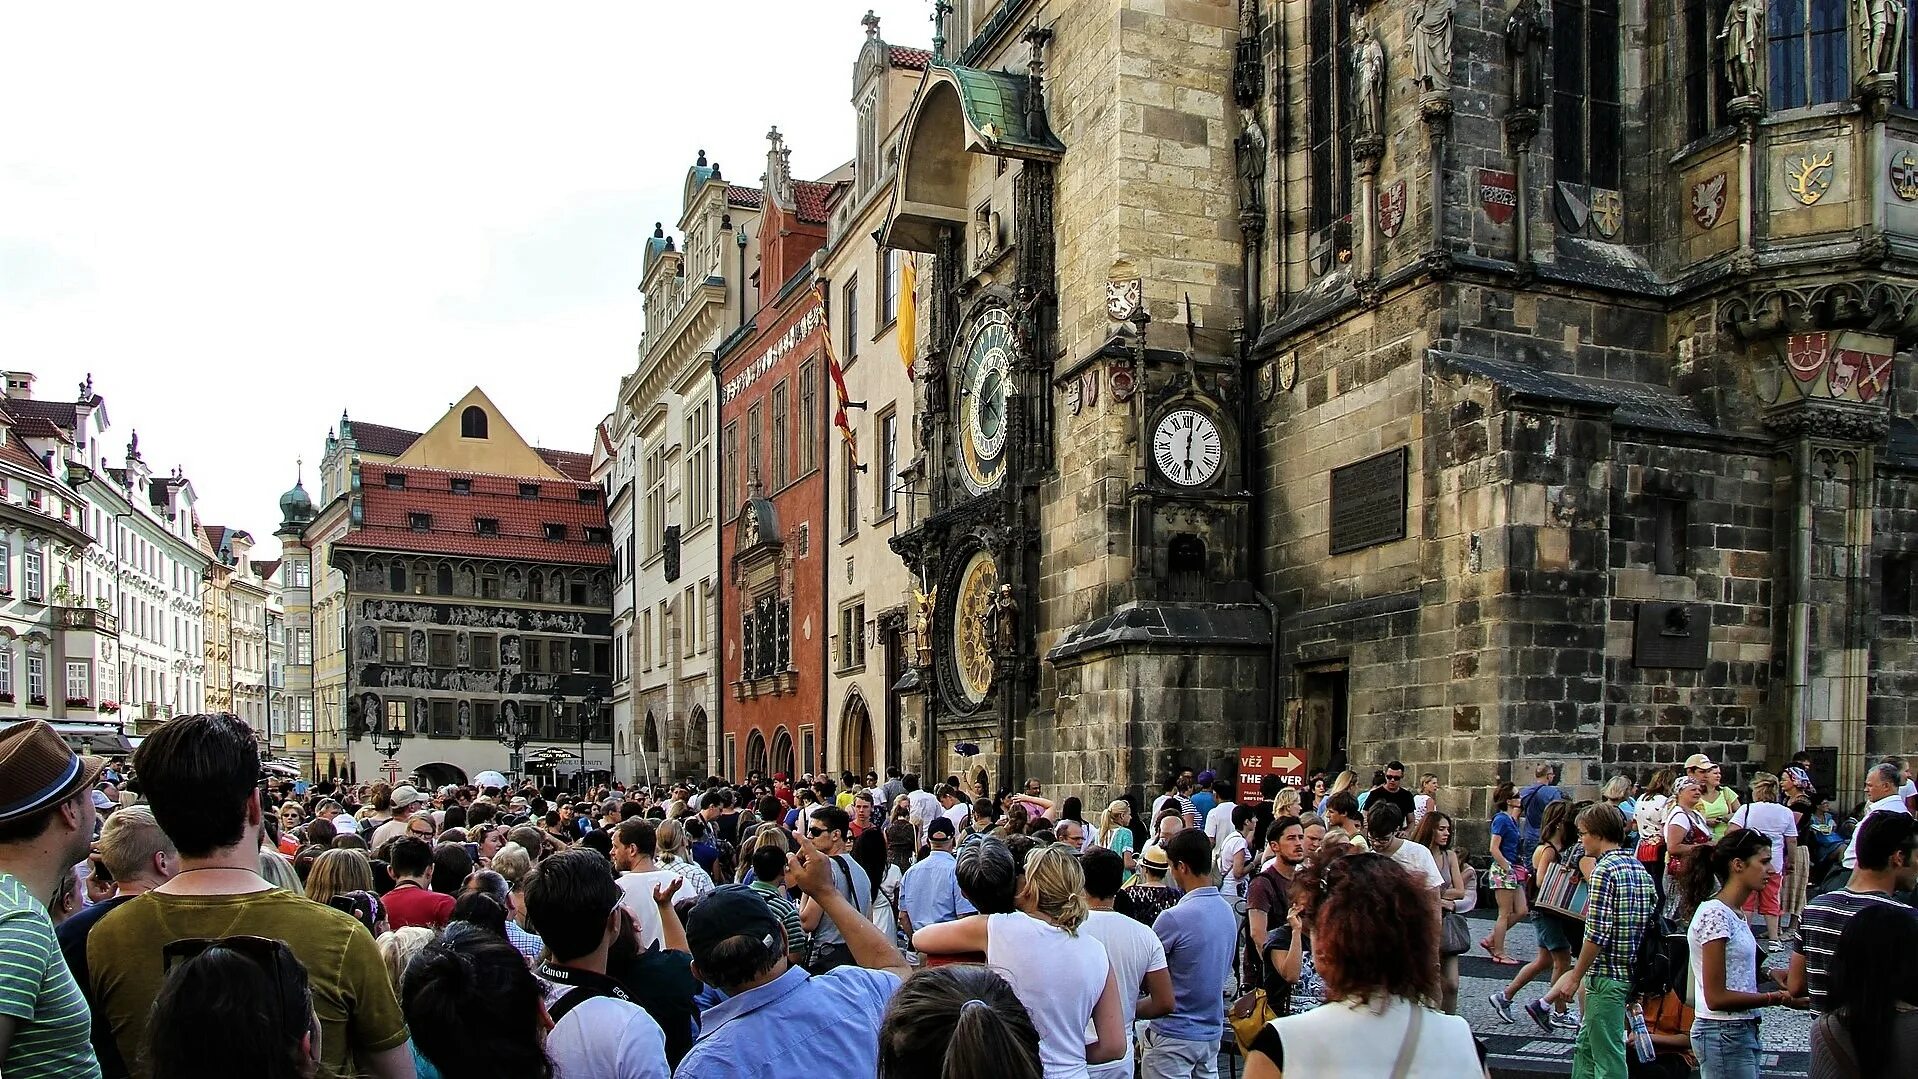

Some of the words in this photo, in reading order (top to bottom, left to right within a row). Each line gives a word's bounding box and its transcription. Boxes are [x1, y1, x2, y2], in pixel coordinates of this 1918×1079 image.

[1241, 756, 1262, 768] VĚŽ
[1240, 774, 1262, 784] THE
[542, 964, 568, 979] Canon
[612, 986, 630, 1001] EOS
